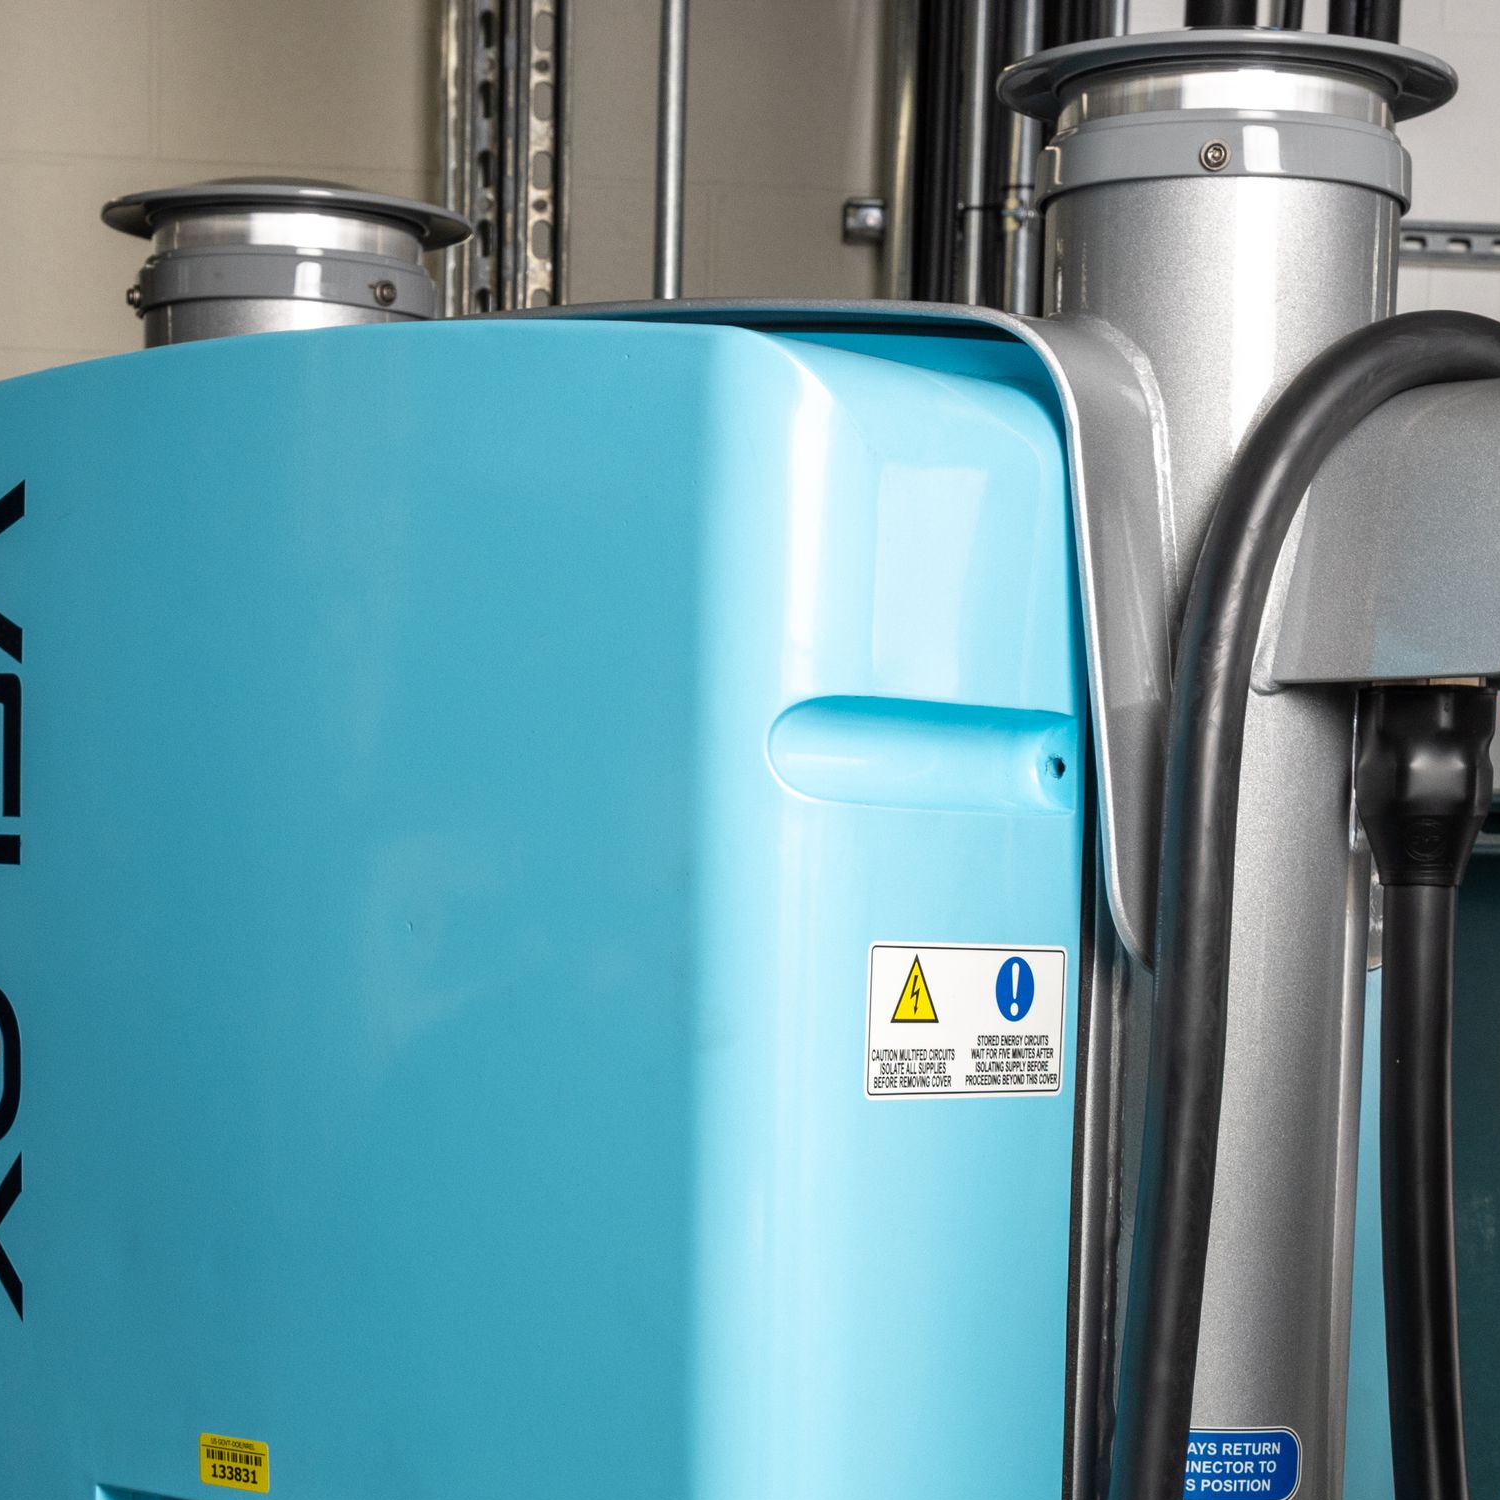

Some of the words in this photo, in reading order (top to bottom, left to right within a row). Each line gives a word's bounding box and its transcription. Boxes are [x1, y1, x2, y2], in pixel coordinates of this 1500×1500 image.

[977, 1035, 999, 1046] STORED
[1001, 1035, 1023, 1046] ENERGY
[1024, 1035, 1048, 1046] CIRCUITS
[872, 1049, 898, 1061] CAUTION
[900, 1049, 927, 1061] MULTIFED
[929, 1049, 955, 1061] CIRCUITS
[971, 1048, 985, 1059] WAIT
[986, 1048, 997, 1059] FOR
[999, 1048, 1010, 1059] FIVE
[1012, 1048, 1035, 1059] MINUTES
[1036, 1048, 1053, 1059] AFTER
[880, 1062, 904, 1075] ISOLATE
[906, 1062, 917, 1074] ALL
[918, 1062, 946, 1074] SUPPLIES
[975, 1061, 1004, 1072] ISOLATING
[1005, 1061, 1026, 1072] SUPPLY
[1027, 1061, 1048, 1072] BEFORE
[874, 1076, 897, 1088] BEFORE
[899, 1075, 930, 1088] REMOVING
[932, 1075, 951, 1087] COVER
[965, 1074, 1001, 1086] PROCEEDING
[1002, 1074, 1024, 1085] BEYOND
[1026, 1074, 1037, 1085] THIS
[1039, 1074, 1057, 1085] COVER
[1187, 1442, 1217, 1456] AYS
[1222, 1442, 1281, 1456] RETURN
[1185, 1460, 1254, 1474] NECTOR
[1259, 1460, 1277, 1473] TO
[211, 1463, 258, 1485] 133831
[1201, 1479, 1271, 1492] POSITION
